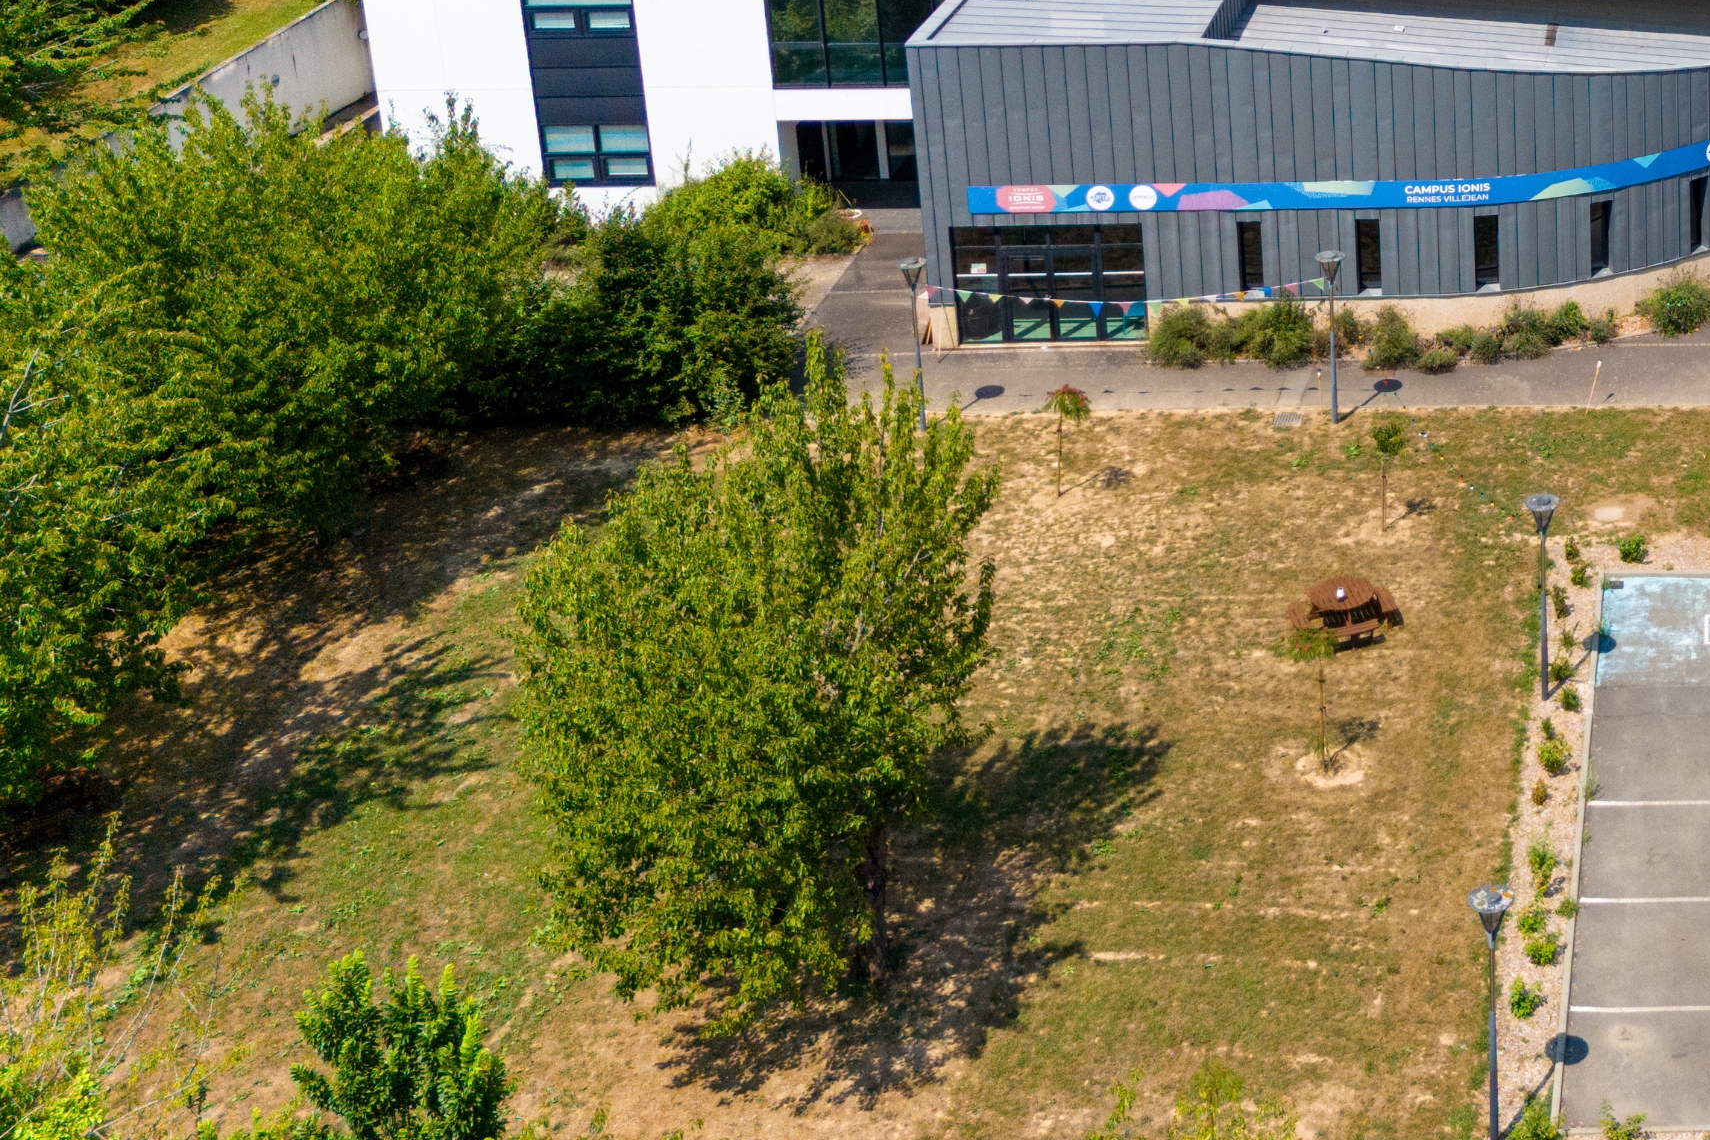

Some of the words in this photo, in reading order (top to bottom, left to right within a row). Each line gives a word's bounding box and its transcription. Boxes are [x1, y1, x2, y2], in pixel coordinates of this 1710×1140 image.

[1404, 185, 1455, 195] CAMPUS
[1458, 182, 1490, 193] IONIS
[1407, 195, 1441, 203] RENNES
[1443, 193, 1489, 203] VILLEJEAN
